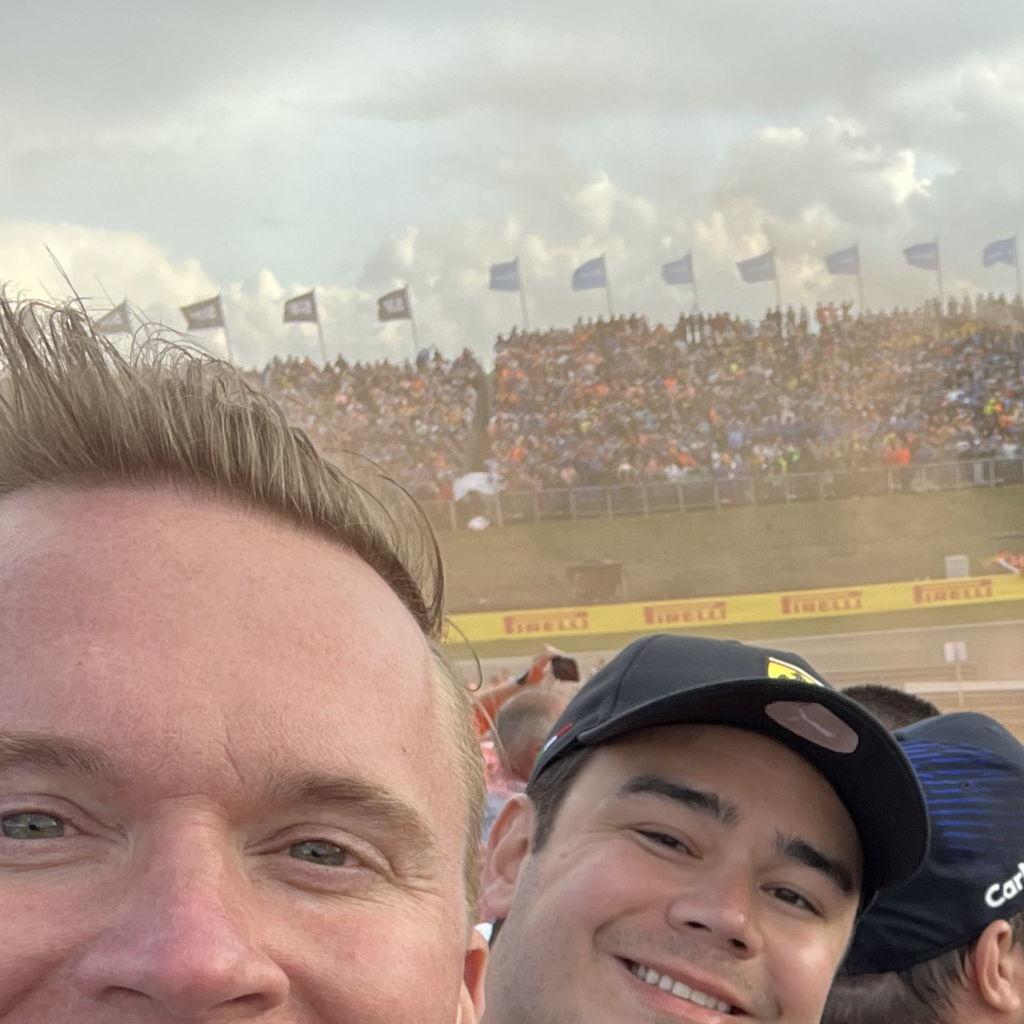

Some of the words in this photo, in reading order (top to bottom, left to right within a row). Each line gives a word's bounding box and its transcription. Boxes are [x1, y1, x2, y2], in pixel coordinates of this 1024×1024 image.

[781, 590, 862, 614] PIRELLI
[912, 579, 992, 604] PIRELLI
[504, 611, 589, 635] PIRELLI
[644, 601, 727, 626] PIRELLI
